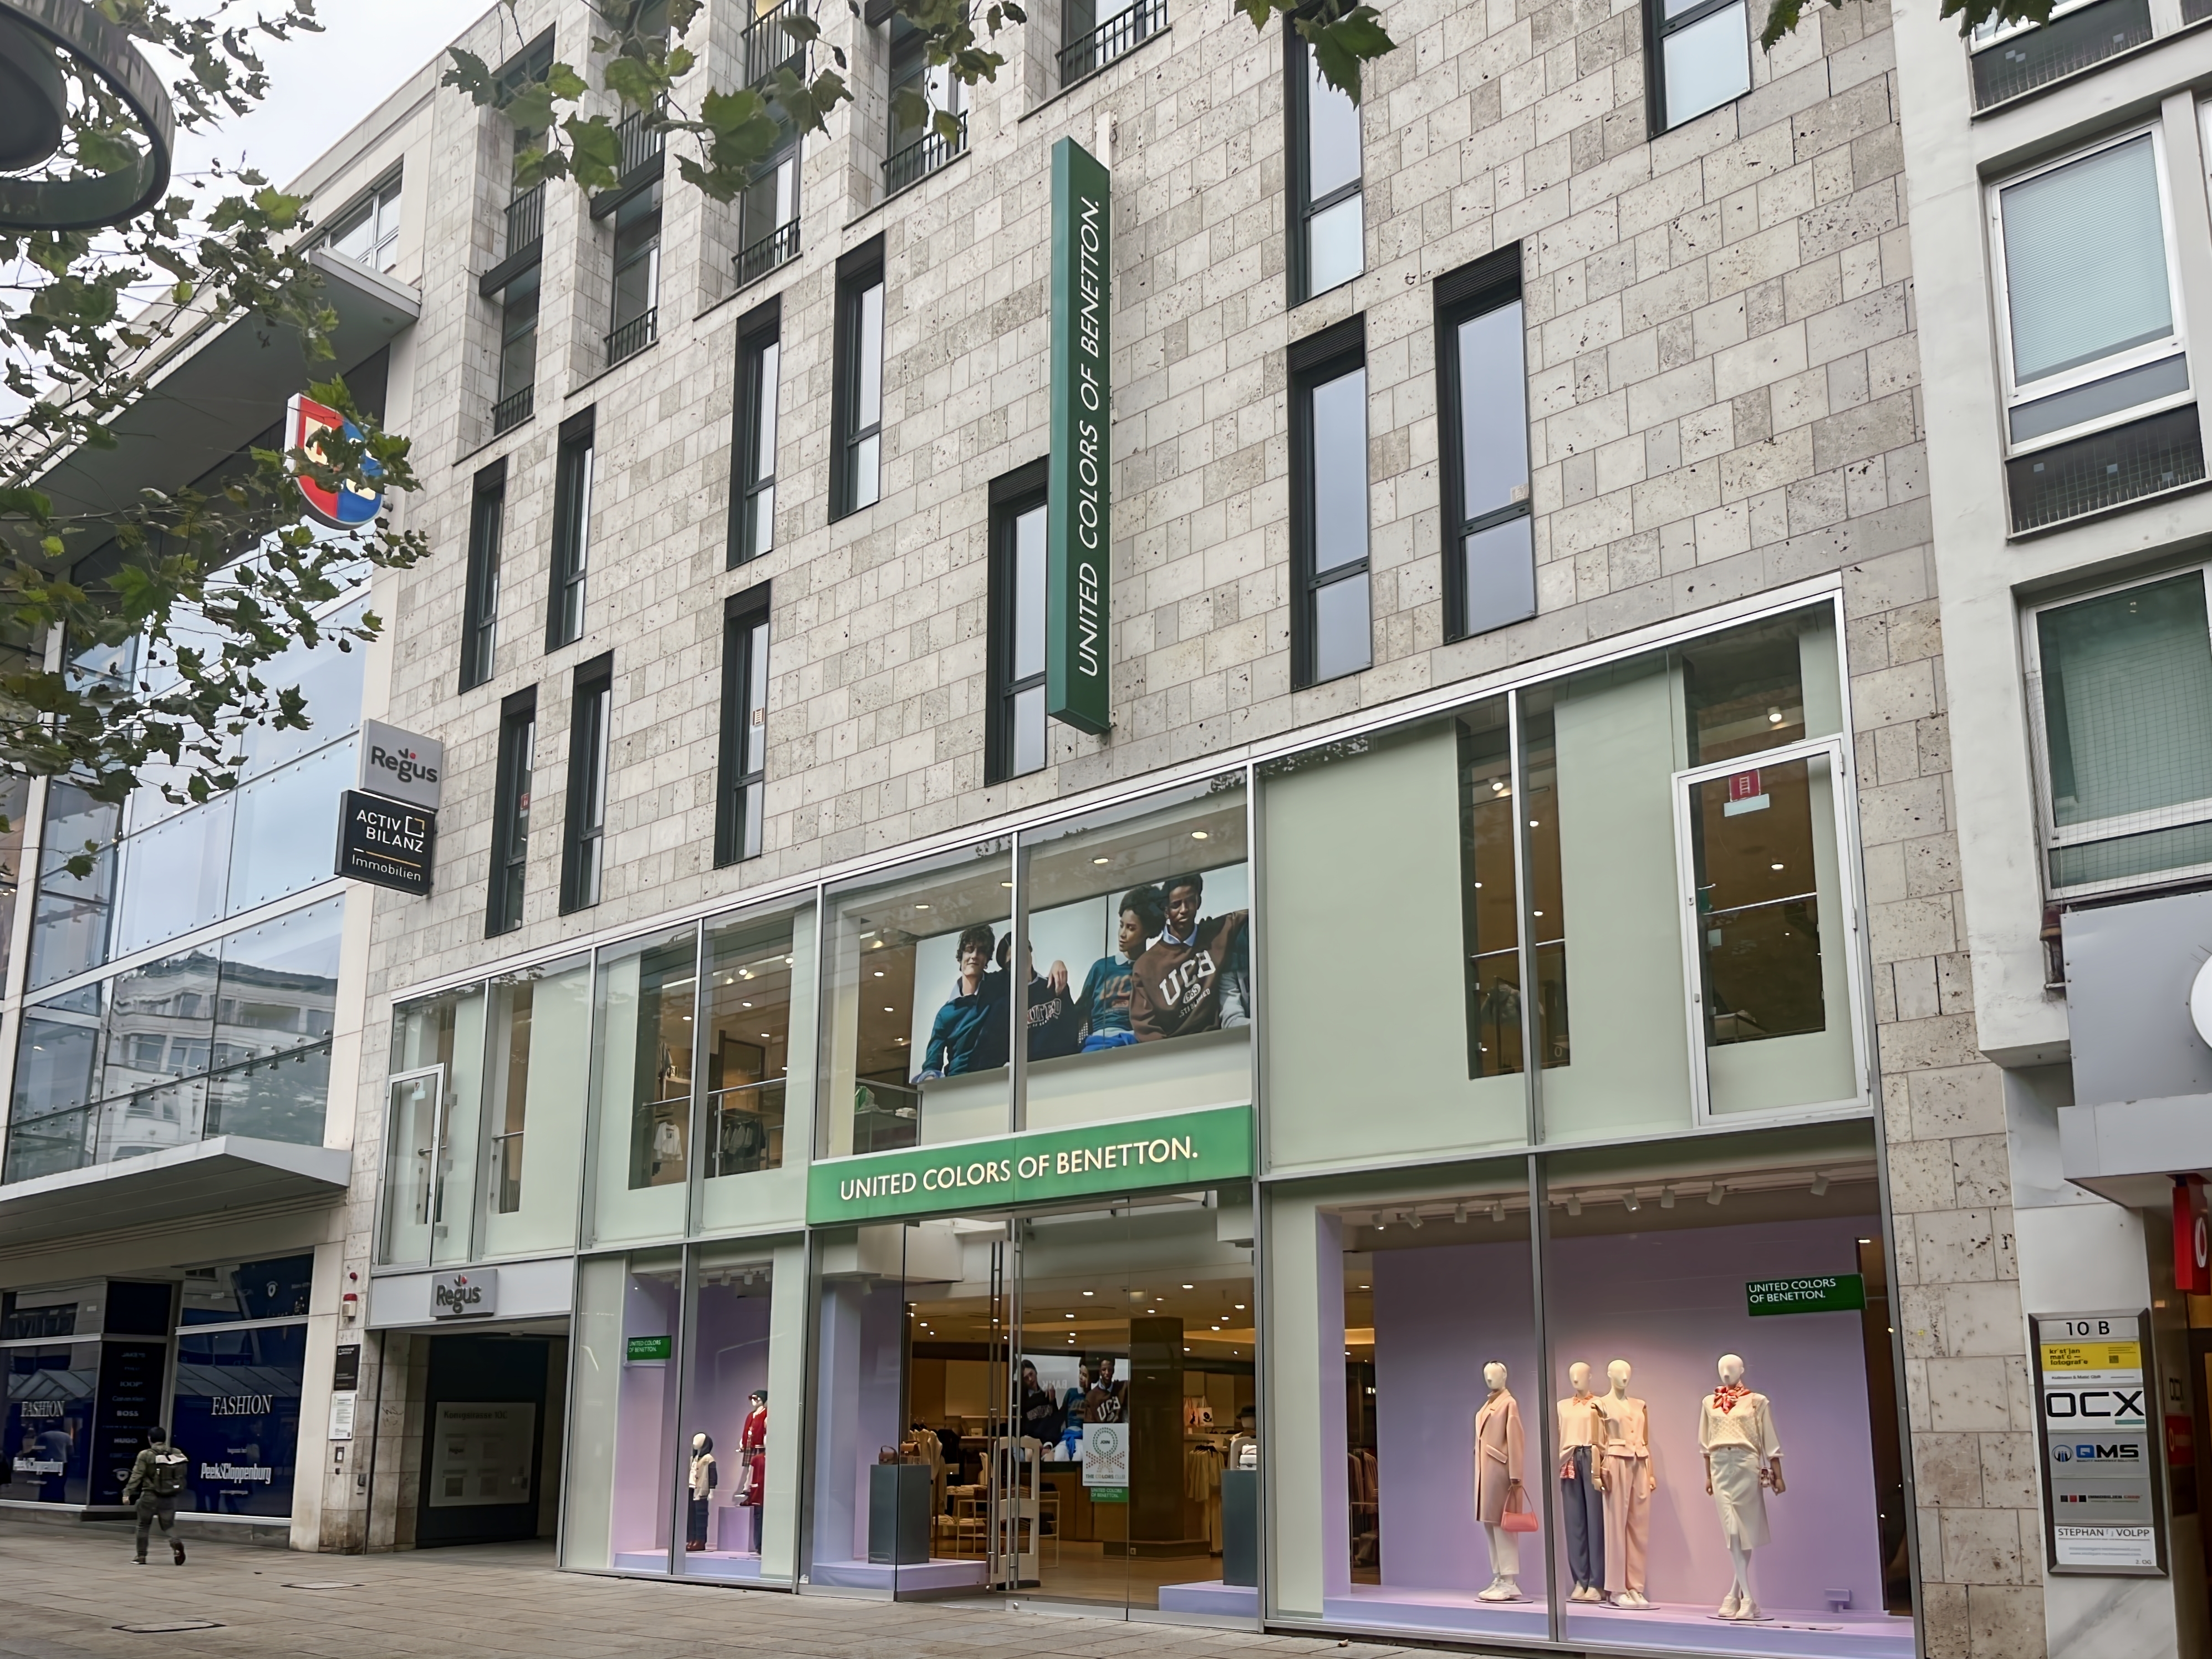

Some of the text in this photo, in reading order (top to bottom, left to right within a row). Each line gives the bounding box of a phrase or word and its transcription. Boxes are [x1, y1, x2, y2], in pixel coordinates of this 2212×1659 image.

[1079, 196, 1099, 676] UNITED COLORS OF BENETTON.
[370, 745, 438, 783] Regus
[356, 810, 401, 831] ACTIV
[366, 826, 424, 853] BILANZ
[351, 854, 421, 882] Immobilien
[1159, 950, 1216, 1005] UCB
[1184, 985, 1200, 1004] 1965
[840, 1136, 1199, 1200] UNITED COLORS OF BENETTON.
[1749, 1278, 1836, 1293] UNITED COLORS
[1750, 1290, 1826, 1303] OF BENETTON.
[435, 1284, 482, 1314] Regus
[2066, 1321, 2110, 1336] 10 B
[21, 1400, 65, 1418] FASHION
[211, 1394, 273, 1415] FASHION
[2046, 1391, 2144, 1417] OCX
[2076, 1444, 2139, 1458] QMS
